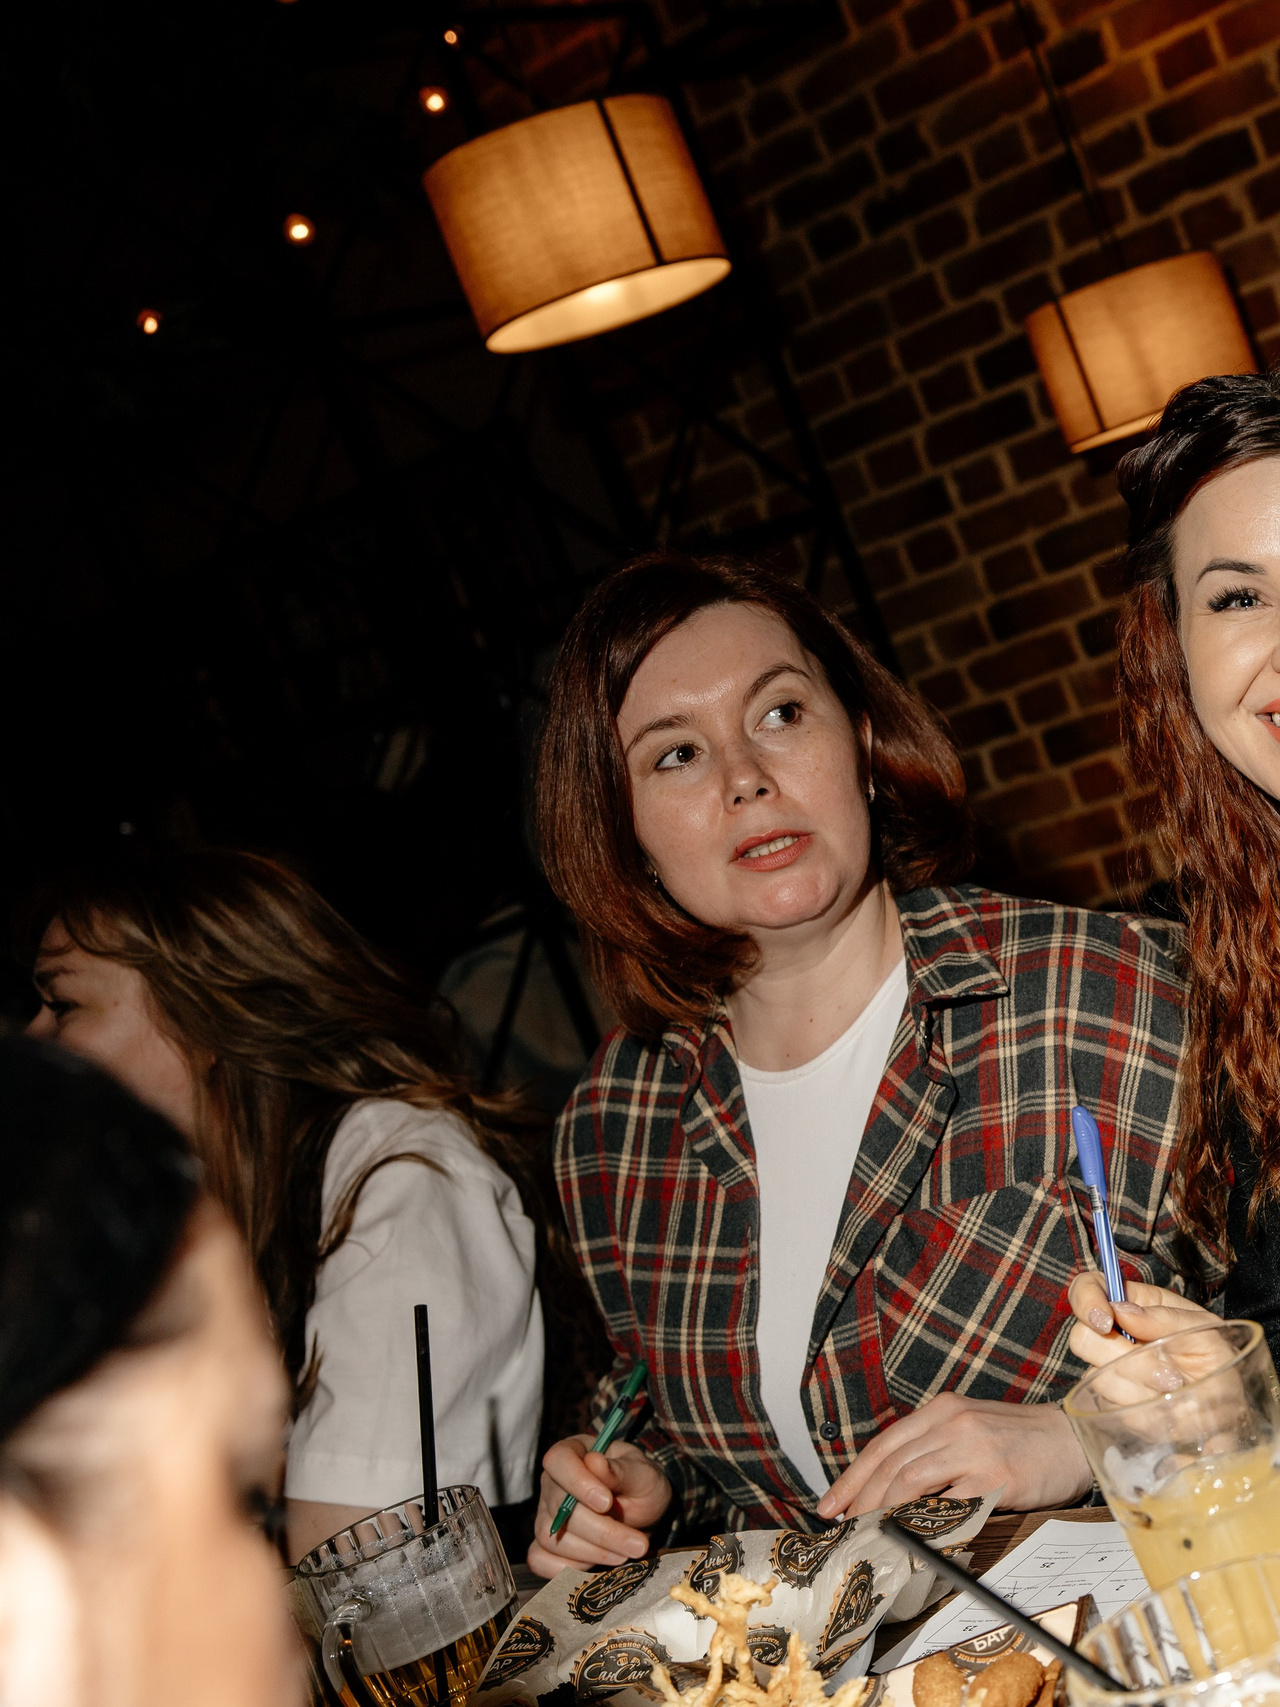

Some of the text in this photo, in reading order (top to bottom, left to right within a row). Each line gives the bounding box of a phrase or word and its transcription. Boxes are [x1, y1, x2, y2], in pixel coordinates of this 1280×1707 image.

[909, 1518, 945, 1529] БАР
[1040, 1561, 1055, 1569] 25
[597, 1588, 623, 1609] БАР
[489, 1658, 512, 1672] АР
[584, 1661, 651, 1683] СанСан
